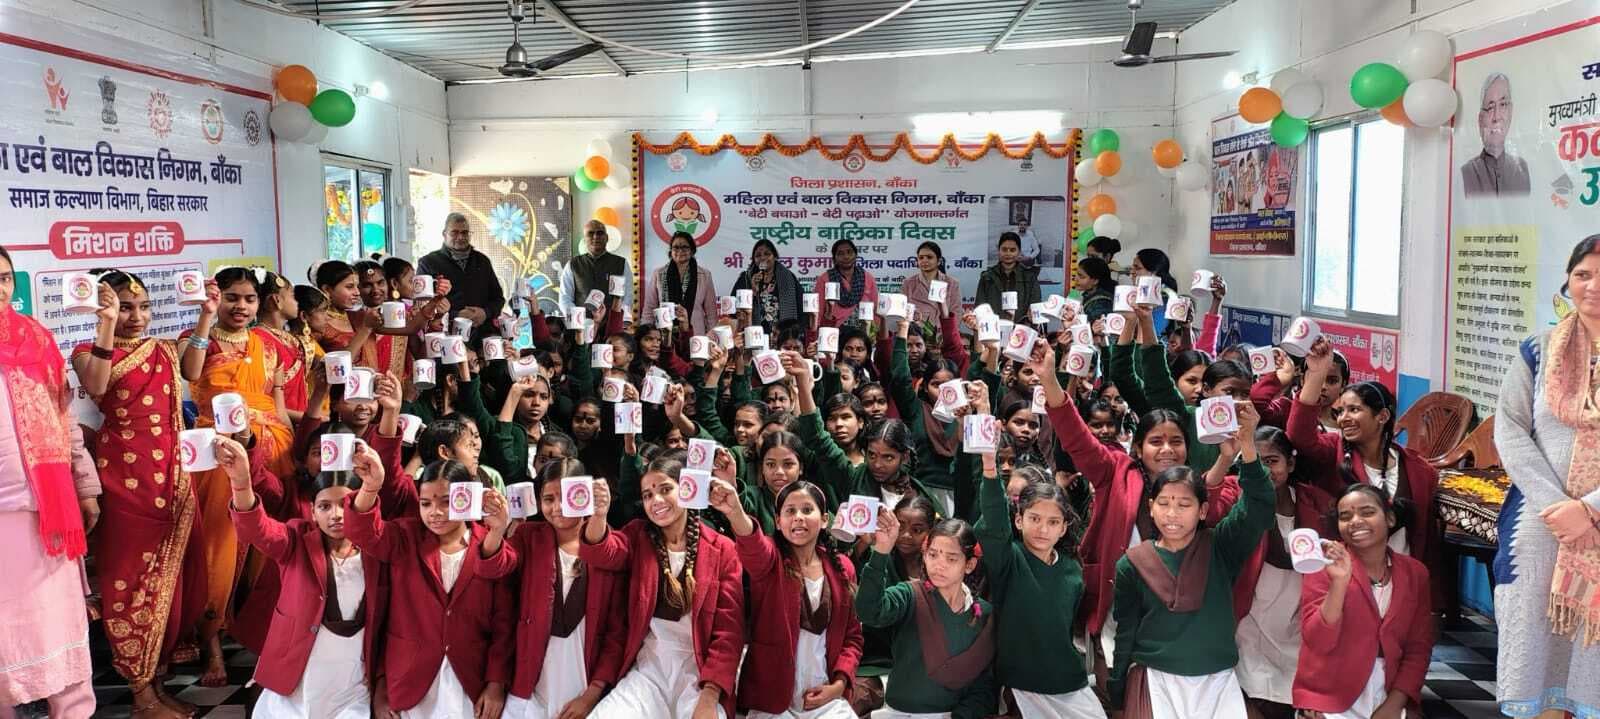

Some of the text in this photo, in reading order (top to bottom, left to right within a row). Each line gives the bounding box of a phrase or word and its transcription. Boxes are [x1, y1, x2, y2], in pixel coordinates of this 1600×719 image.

[1548, 92, 1598, 128] मुख्यमंत्री
[13, 135, 48, 174] एवं
[51, 146, 93, 177] बाल
[95, 140, 154, 181] विकास
[158, 147, 208, 185] निगम,
[210, 154, 242, 185] बाँका
[790, 176, 918, 190] जिला प्रशासन, बाँका
[8, 186, 208, 213] समाज कल्याण विभाग, बिहार सरकार
[723, 190, 986, 206] महिला एवं बाल विकास निगम, बाँका
[771, 207, 808, 219] बचाओ
[822, 207, 842, 219] बेटी
[893, 208, 969, 219] योजनान्तर्गत
[63, 225, 175, 256] मिशन शक्ति
[750, 221, 957, 245] राष्ट्रीय बालिका दिवस
[815, 243, 828, 254] के
[871, 245, 889, 254] पर
[723, 251, 745, 269] श्री
[796, 256, 833, 274] कुमा
[954, 256, 984, 269] बाँका
